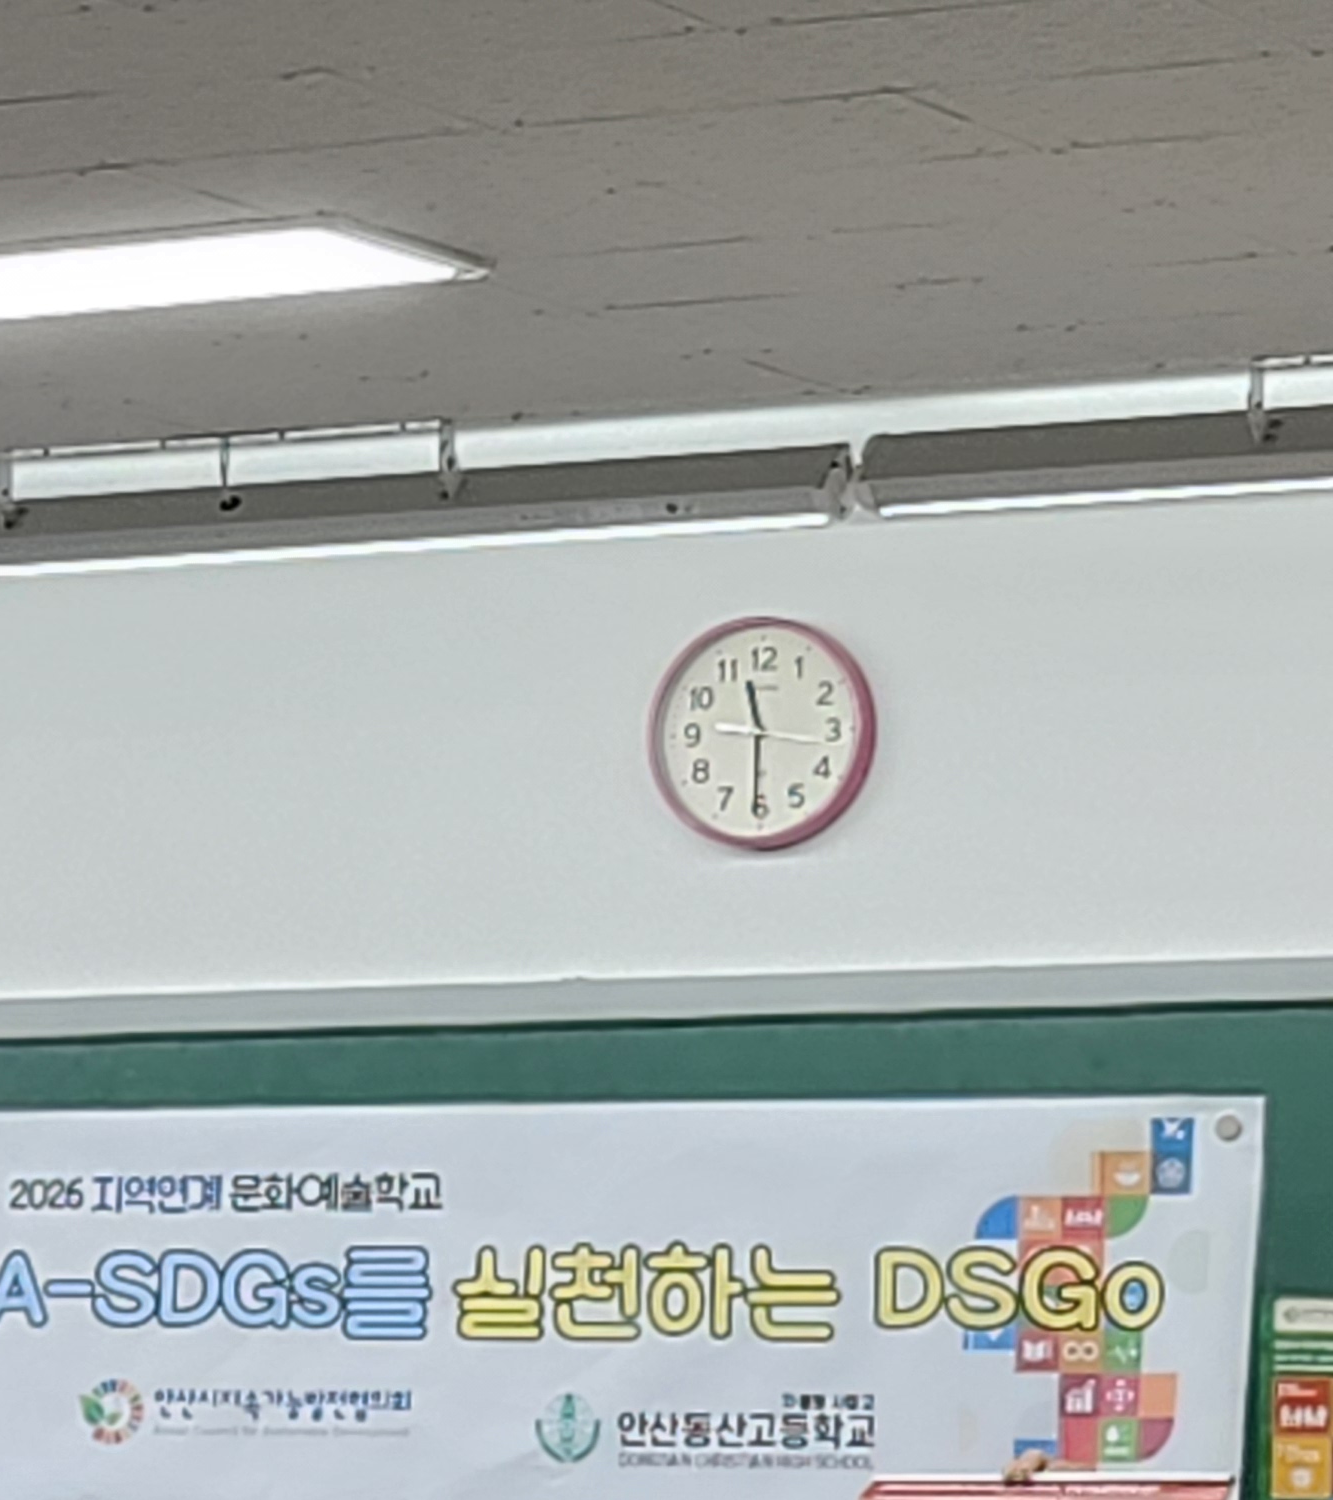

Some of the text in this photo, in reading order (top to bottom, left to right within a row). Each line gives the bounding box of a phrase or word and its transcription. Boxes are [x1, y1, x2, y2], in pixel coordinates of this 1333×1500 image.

[717, 659, 738, 682] 11
[751, 646, 778, 671] 12
[795, 656, 803, 679] 1
[690, 686, 714, 711] 10
[815, 681, 835, 706] 2
[683, 722, 702, 748] 9
[824, 717, 842, 743] 3
[691, 758, 710, 784] 8
[813, 755, 831, 779] 4
[717, 786, 734, 811] 7
[787, 783, 806, 809] 5
[8, 1173, 444, 1213] 2026 지역연계 문화예술학교
[452, 1241, 840, 1343] 실천하는
[873, 1244, 1166, 1332] DSGo
[616, 1410, 876, 1450] 안산동산고등학교
